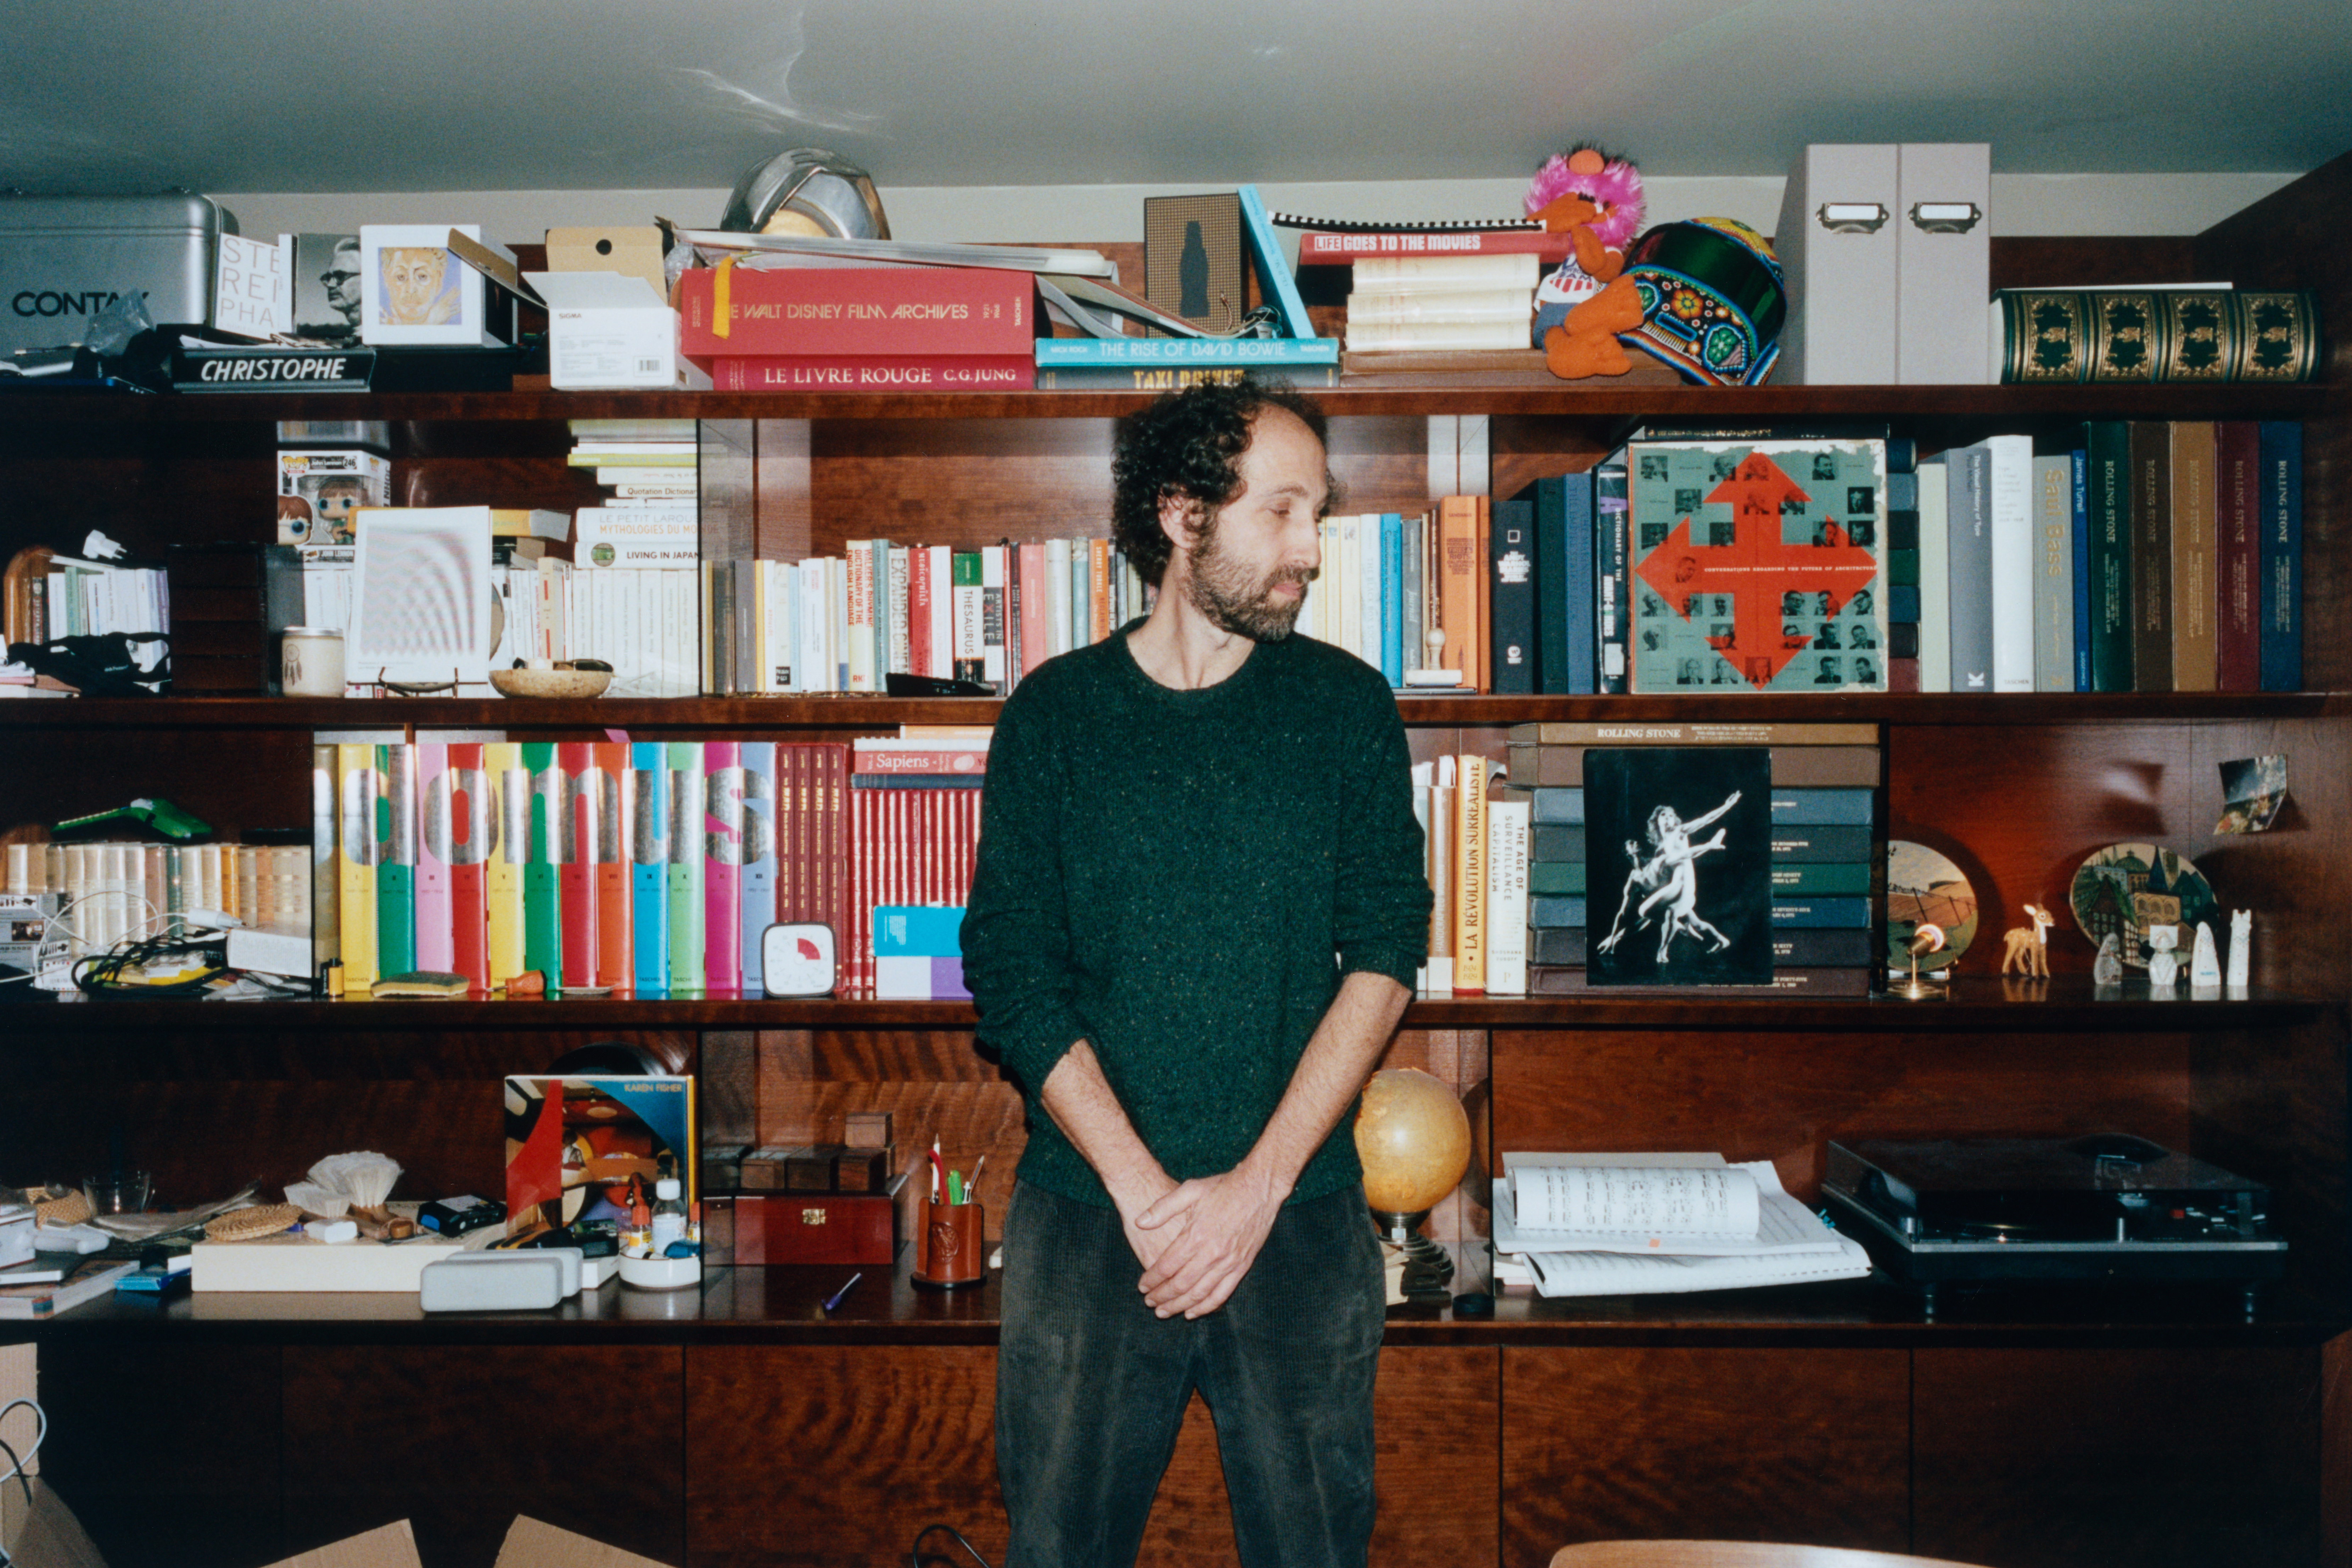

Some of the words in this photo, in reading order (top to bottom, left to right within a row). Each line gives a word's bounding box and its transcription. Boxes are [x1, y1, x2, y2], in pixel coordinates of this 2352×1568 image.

[1316, 238, 1339, 249] LIFE
[1343, 236, 1377, 251] GOES
[1380, 236, 1397, 250] TO
[1400, 235, 1425, 250] THE
[1427, 235, 1480, 250] MOVIES
[222, 267, 277, 303] REI
[220, 298, 274, 328] PHA
[745, 304, 781, 318] WALT
[788, 304, 842, 318] DISNEY
[849, 304, 887, 318] FILM
[891, 304, 968, 319] ARCHIVES
[1101, 343, 1125, 356] THE
[1131, 343, 1159, 356] RISE
[1165, 343, 1186, 356] OF
[1192, 343, 1232, 355] DAVID
[1238, 342, 1286, 355] BOWIE
[201, 358, 346, 381] CHRISTOPHE
[765, 368, 786, 383] LE
[794, 368, 853, 383] LIVRE
[861, 368, 932, 383] ROUGE
[975, 369, 1016, 383] JUNG
[1134, 370, 1172, 389] TAXI
[344, 459, 356, 467] 246
[2075, 457, 2084, 483] James
[2045, 469, 2065, 516] Saul
[2076, 486, 2085, 512] Turrell
[2105, 460, 2115, 506] ROLLING
[2278, 460, 2287, 506] ROLLING
[599, 525, 664, 534] MYTHOLOGIES
[667, 525, 679, 534] DU
[1600, 497, 1627, 514] A
[1615, 555, 1622, 565] OF
[2106, 509, 2116, 543] STONE
[2278, 509, 2288, 543] STONE
[2046, 524, 2065, 577] Bass
[864, 549, 873, 588] WALKER'S
[856, 599, 863, 607] OF
[891, 558, 907, 629] EXPANDED
[1407, 589, 1417, 623] Journal
[1603, 576, 1614, 637] AVANT-GARDES
[964, 590, 973, 654] THESAURUS
[984, 594, 994, 639] EXILE
[996, 631, 1002, 639] IN
[1597, 729, 1643, 738] ROLLING
[1646, 729, 1680, 738] STONE
[877, 754, 929, 772] Sapiens
[1464, 763, 1479, 845] SURRÉALISTE
[1492, 824, 1500, 892] CAPITALISM
[1504, 816, 1513, 901] SURVEILLANCE
[1435, 864, 1445, 896] MODERN
[1463, 849, 1478, 927] RÉVOLUTION
[1516, 877, 1523, 890] OF
[1436, 898, 1445, 952] HANDCRAFTED
[1465, 934, 1478, 950] LA
